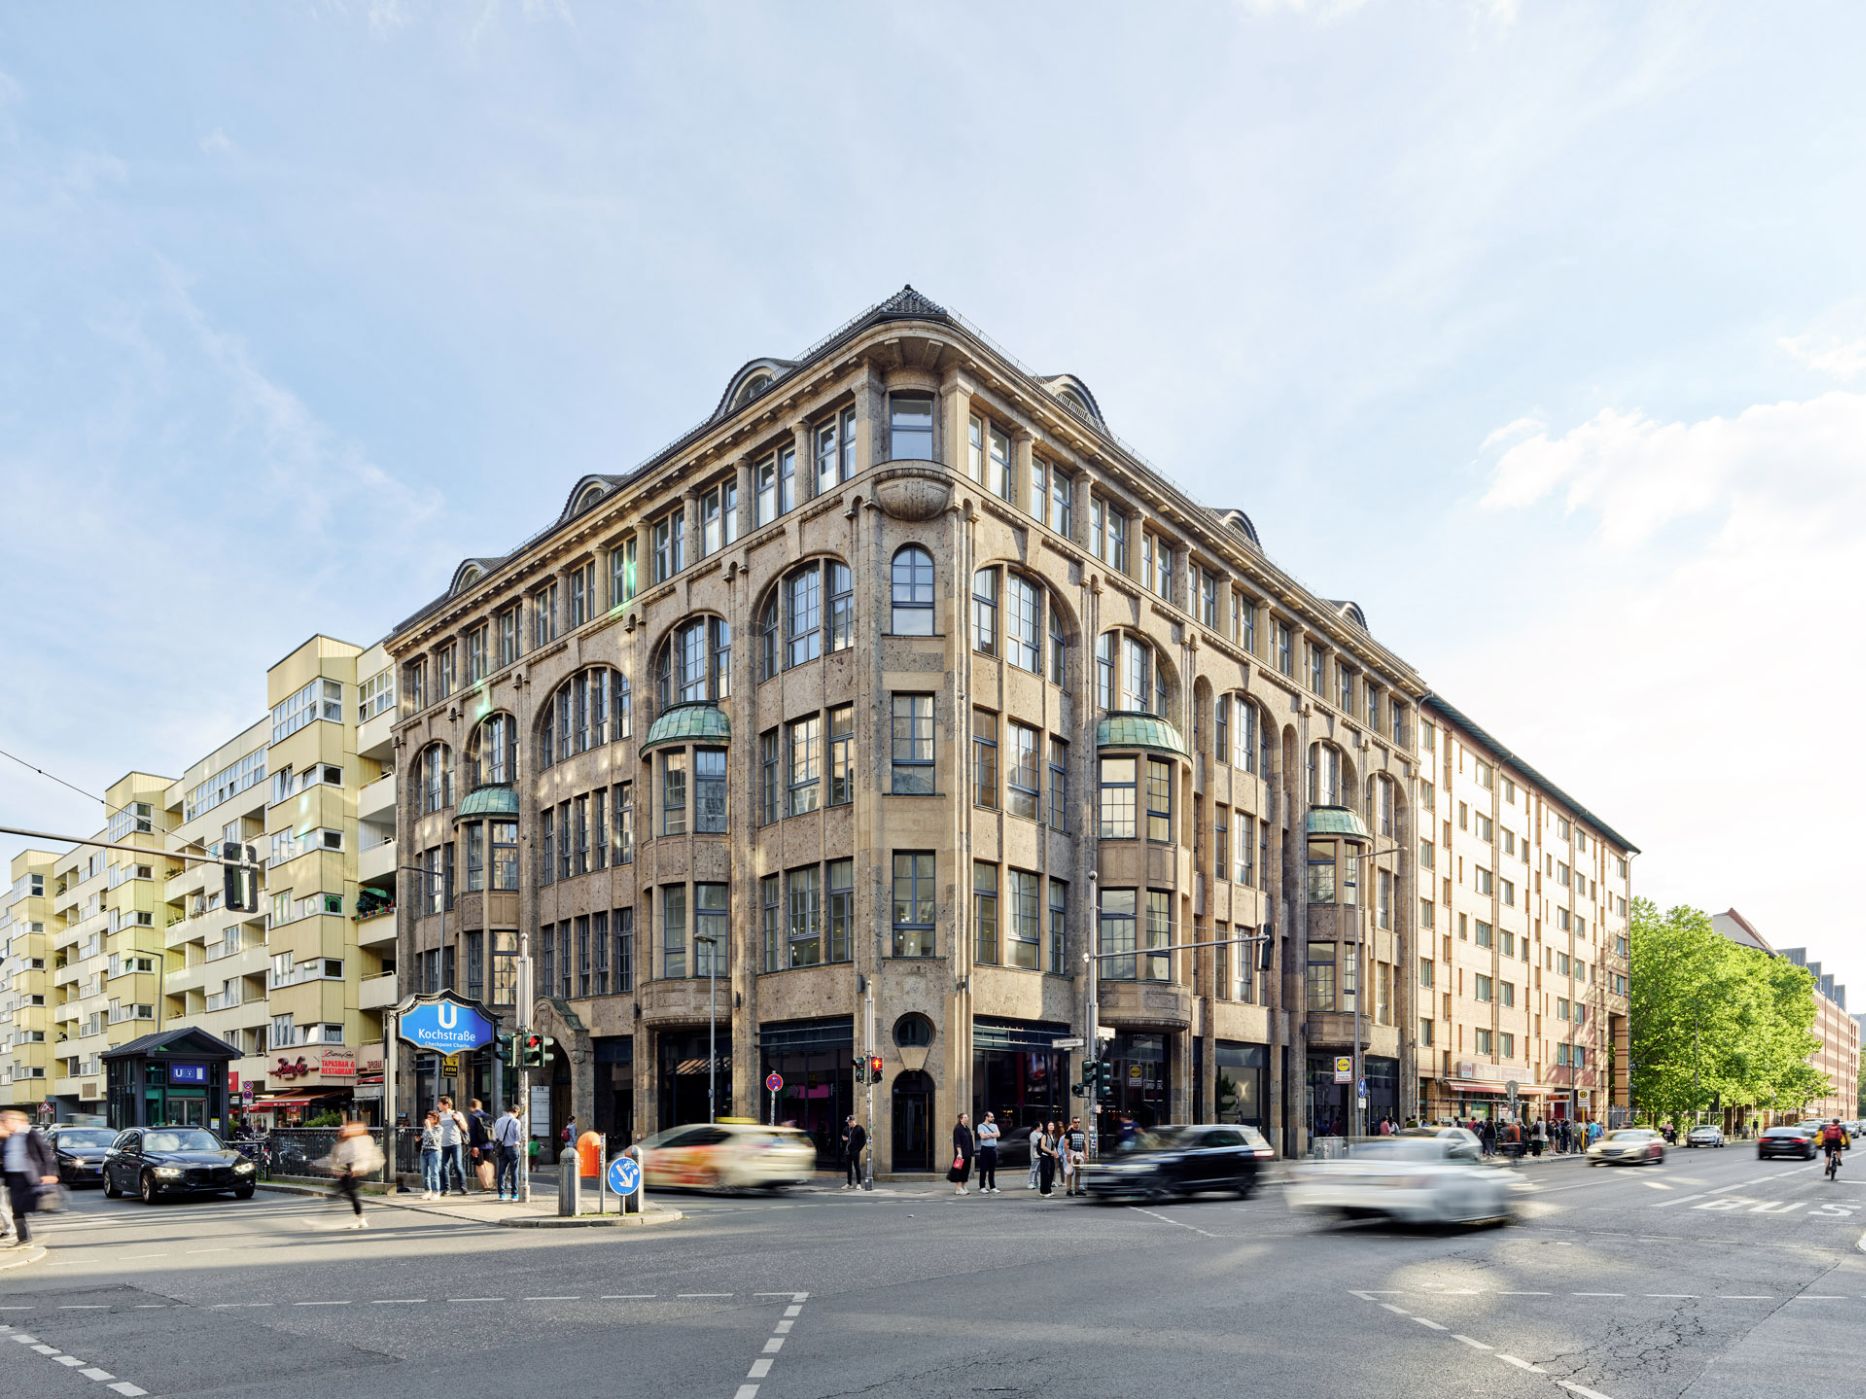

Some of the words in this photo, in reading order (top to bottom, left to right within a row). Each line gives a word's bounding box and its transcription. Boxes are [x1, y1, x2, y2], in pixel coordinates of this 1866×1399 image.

[438, 1004, 457, 1029] U
[418, 1028, 476, 1041] Kochstraße
[1690, 1199, 1862, 1216] BUS
